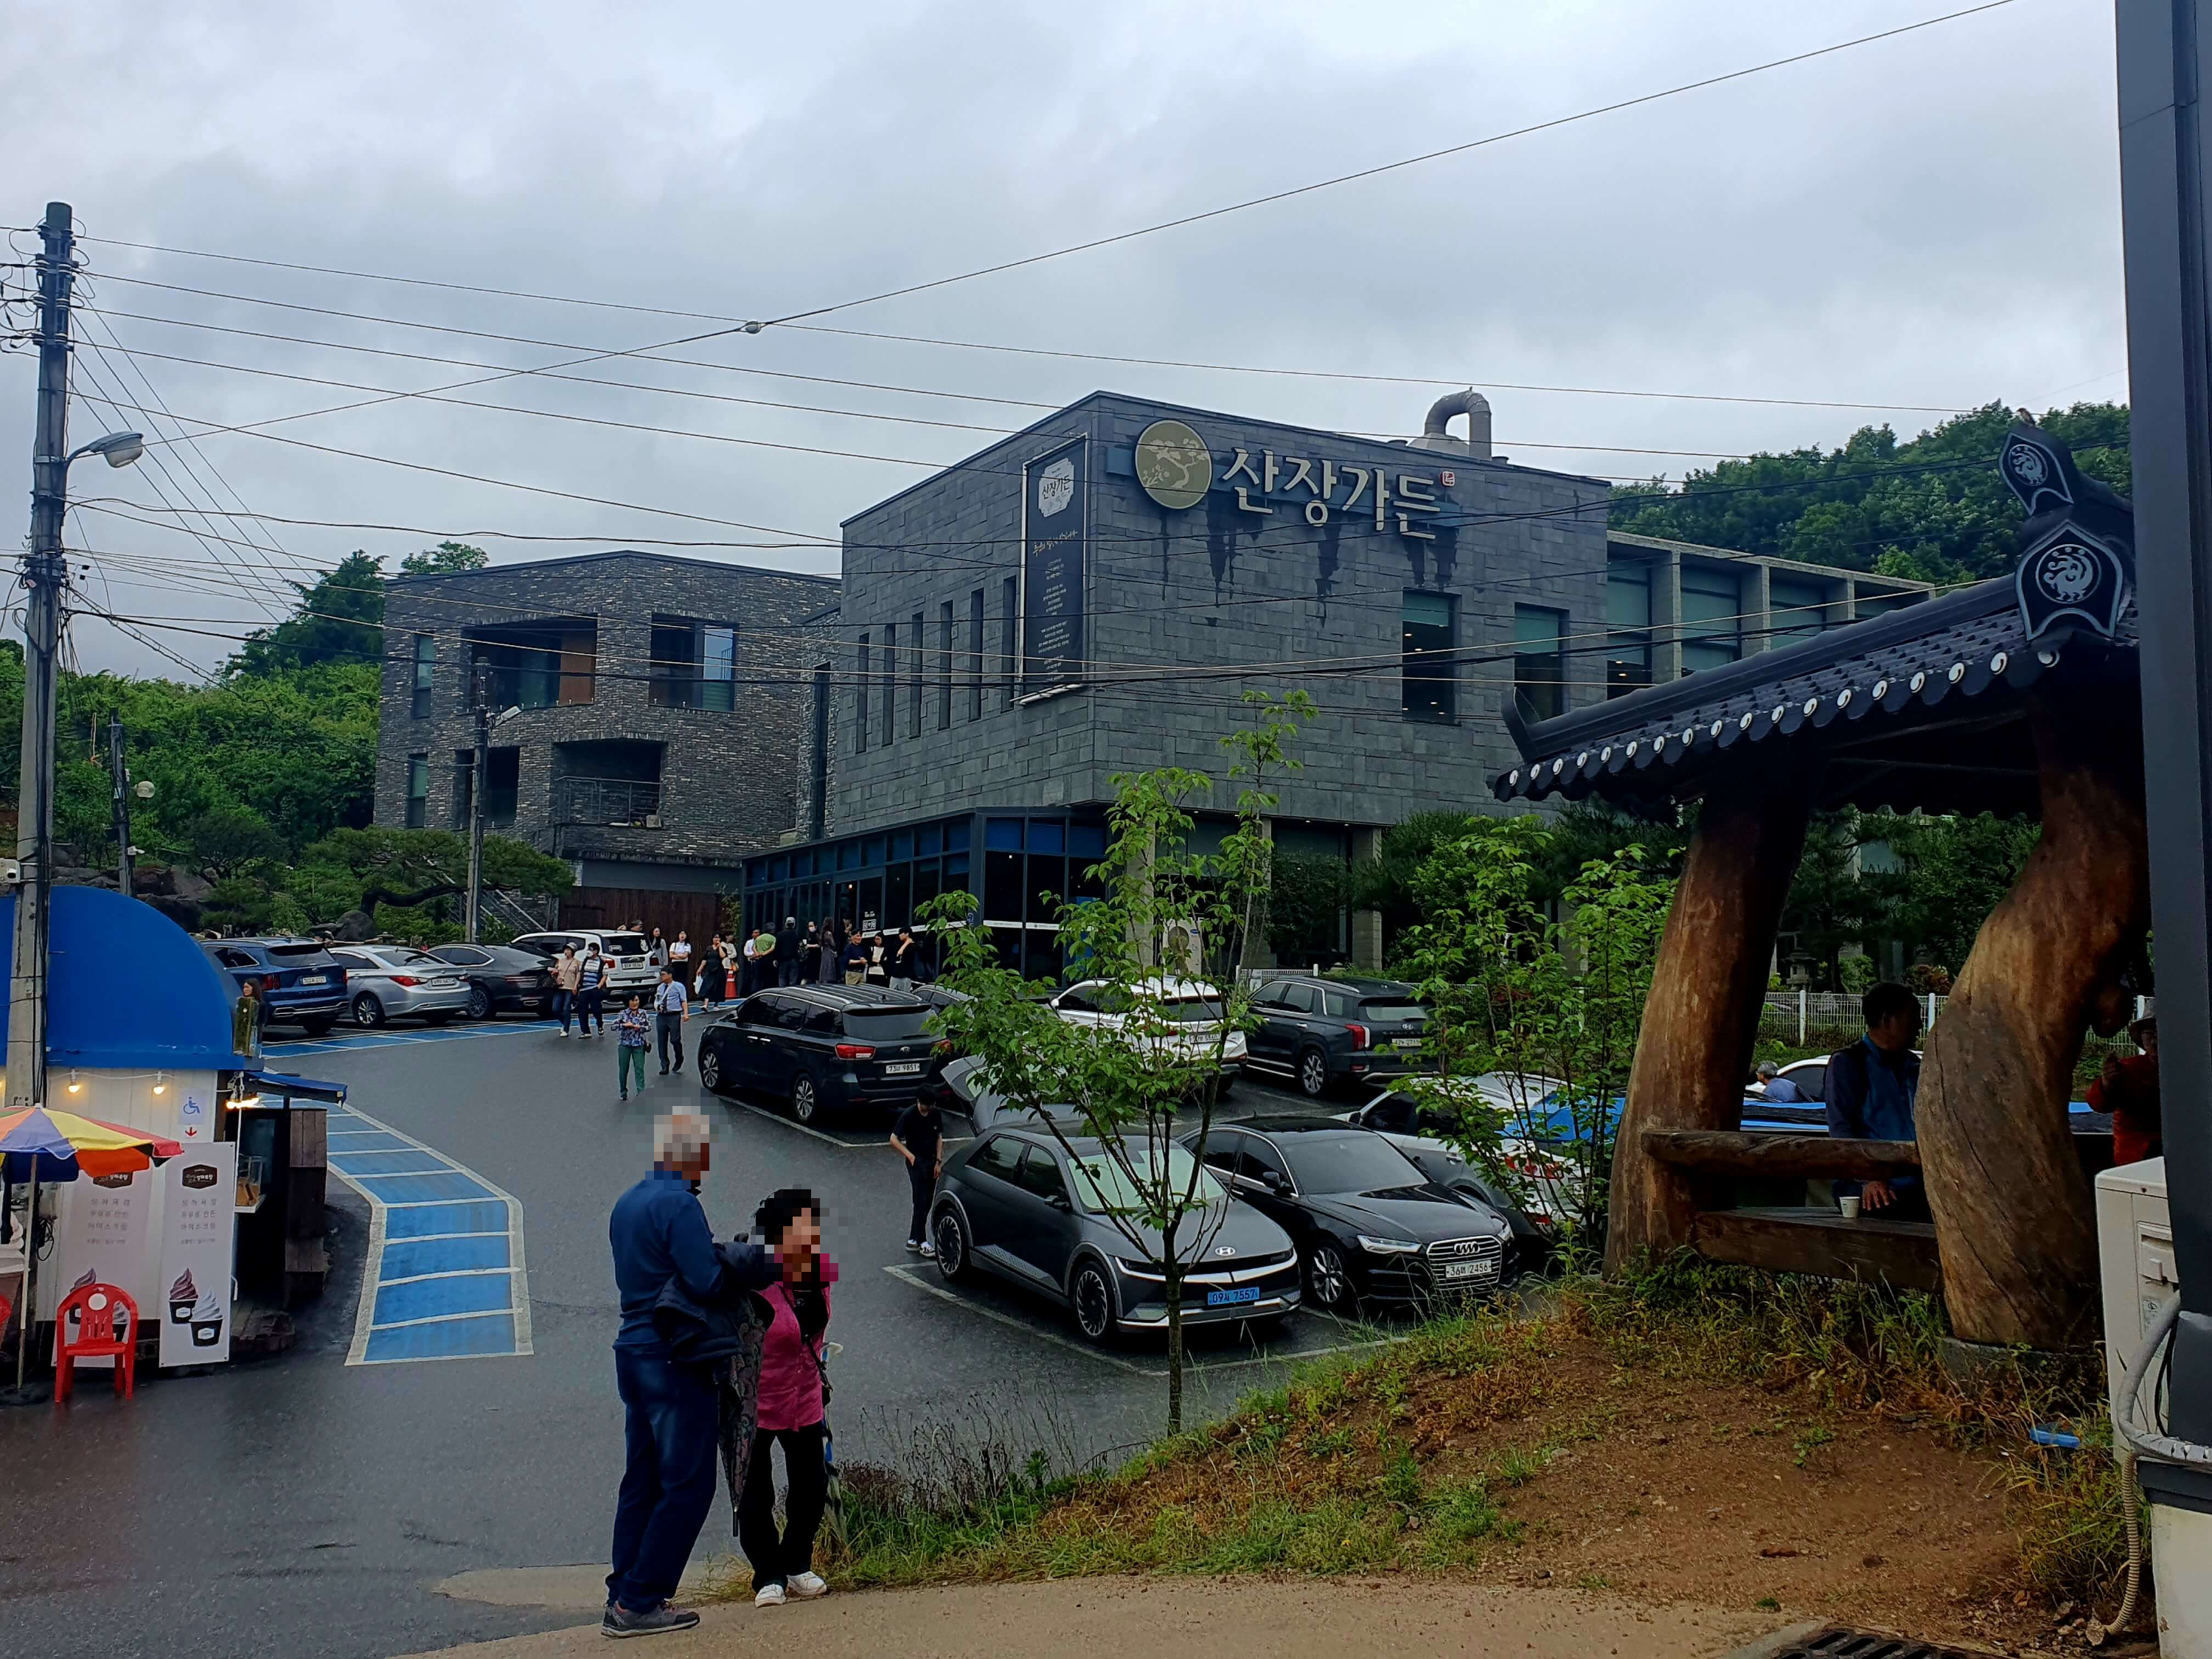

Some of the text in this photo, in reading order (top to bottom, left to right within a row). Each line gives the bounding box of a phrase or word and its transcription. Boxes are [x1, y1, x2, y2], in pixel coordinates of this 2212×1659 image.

[1041, 474, 1071, 500] 산장가든
[1221, 447, 1441, 540] 산장가든
[1469, 1262, 1489, 1274] 2456
[1233, 1287, 1256, 1301] 7557
